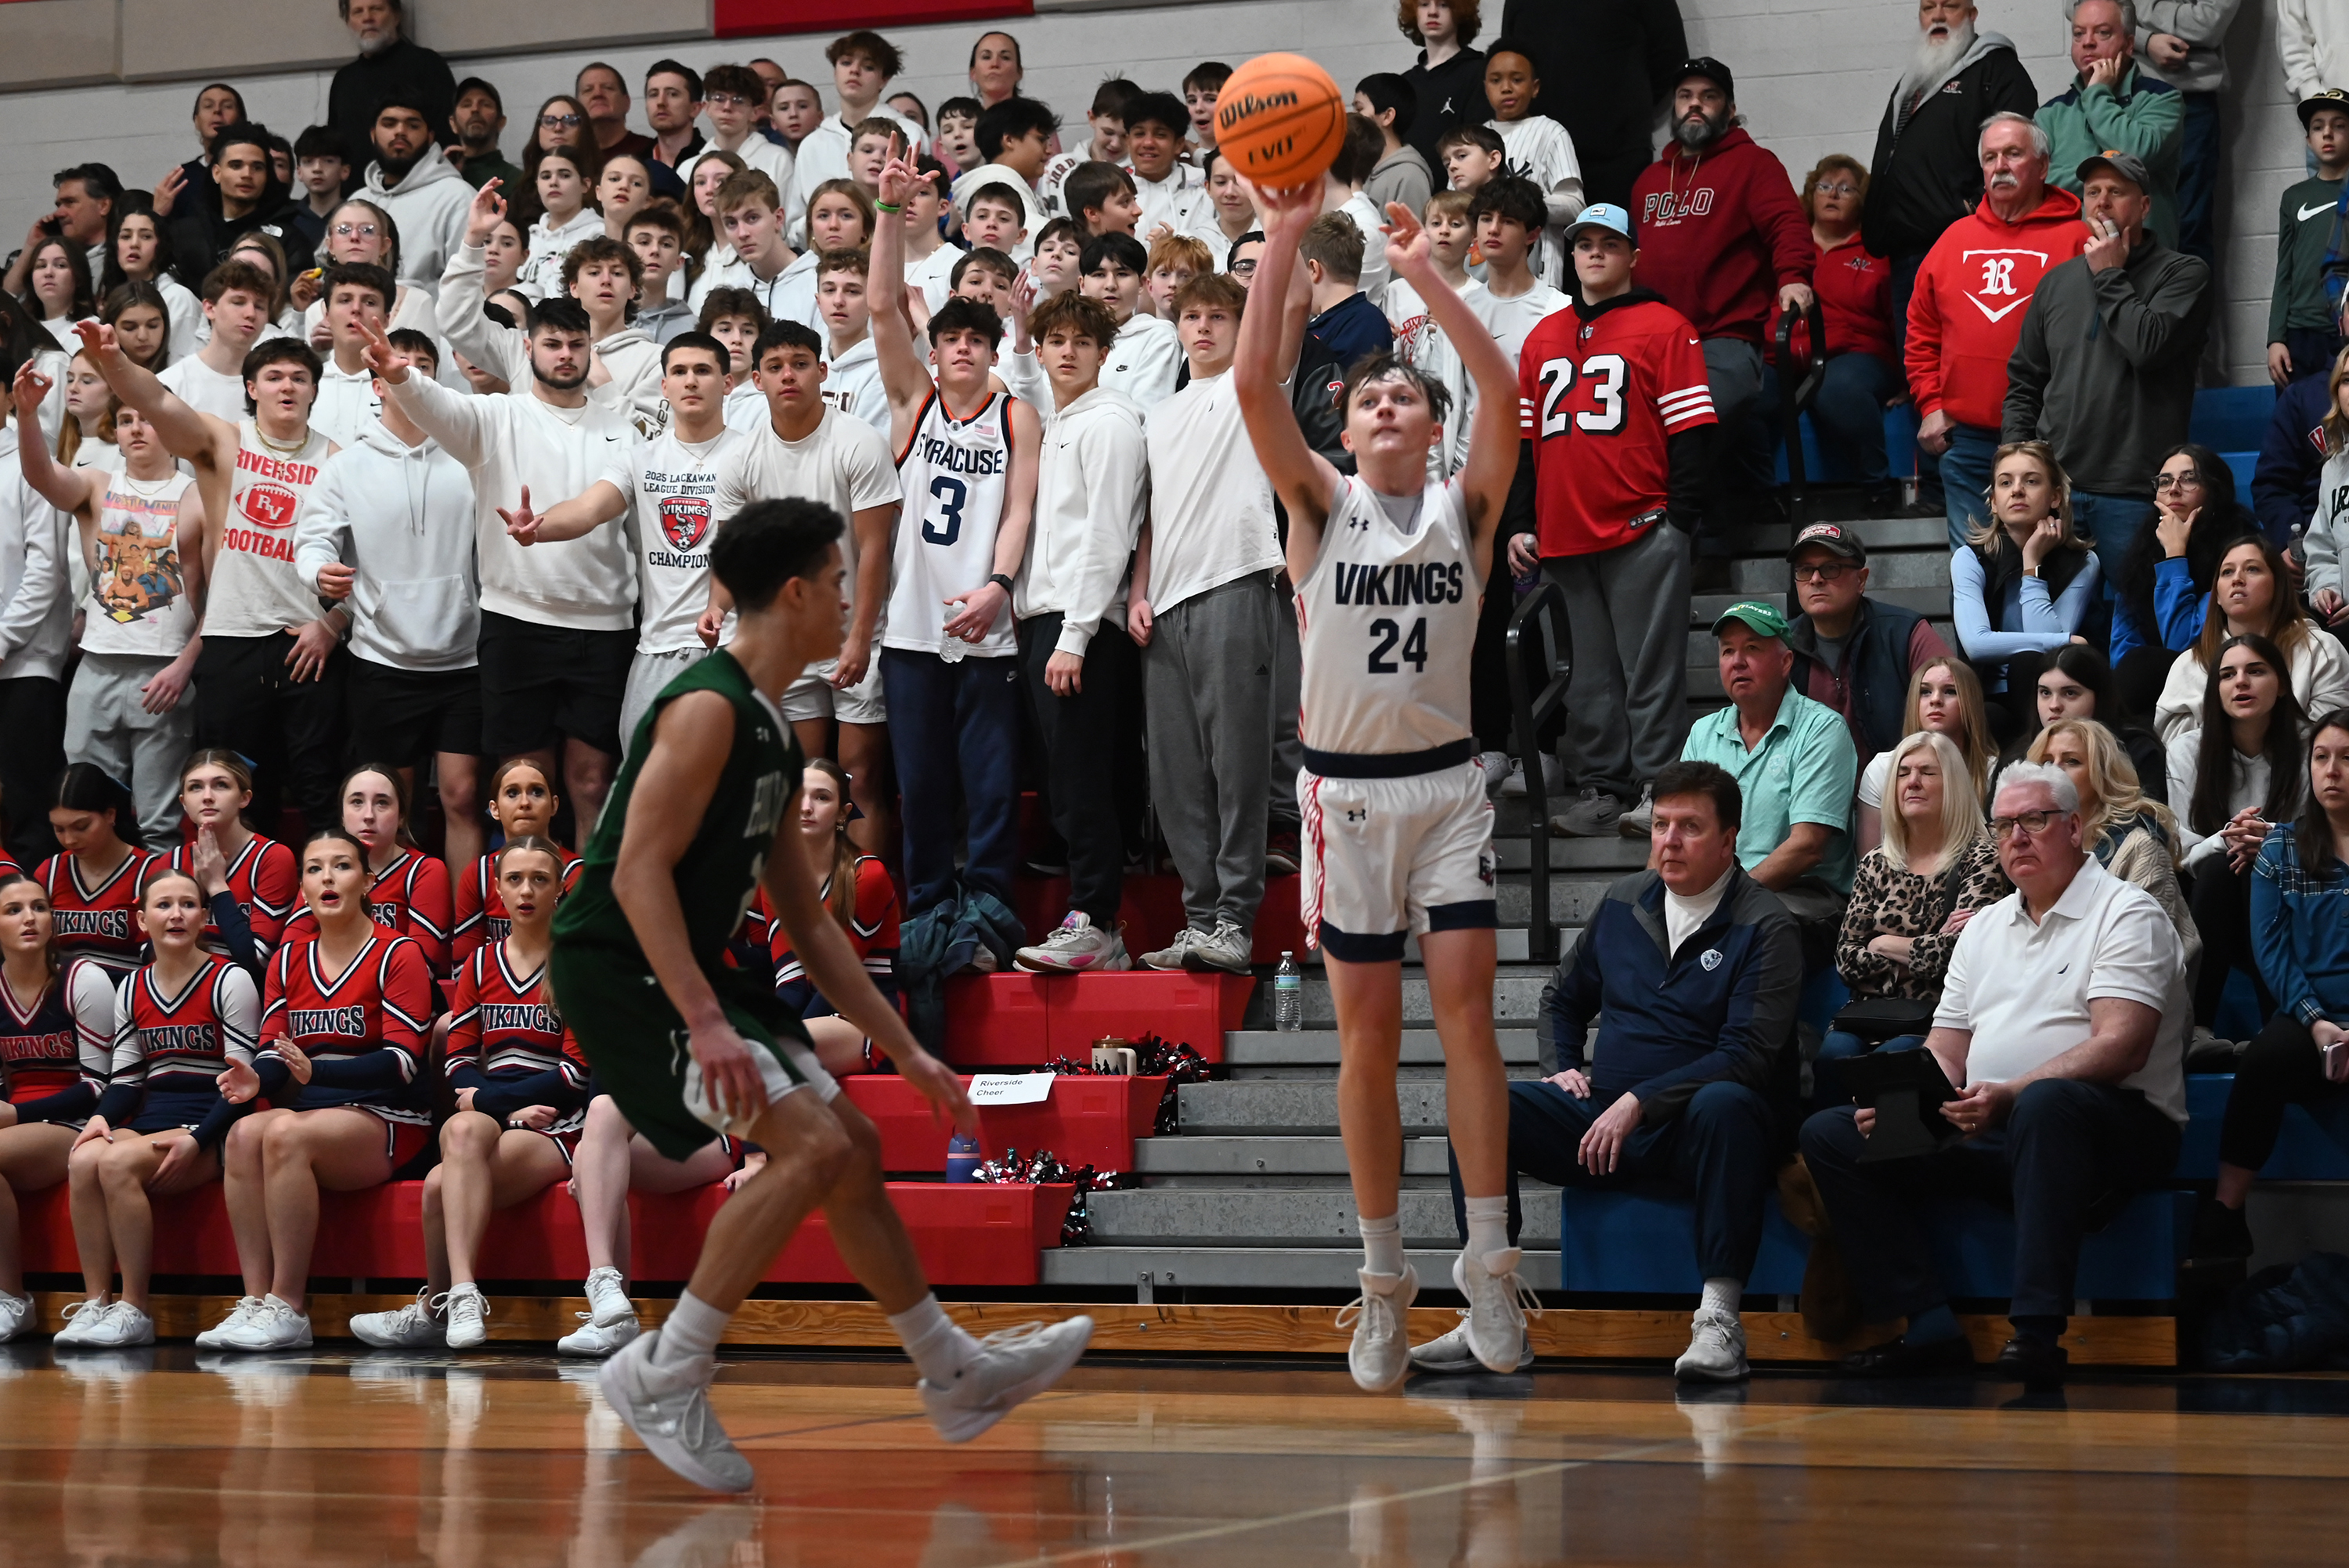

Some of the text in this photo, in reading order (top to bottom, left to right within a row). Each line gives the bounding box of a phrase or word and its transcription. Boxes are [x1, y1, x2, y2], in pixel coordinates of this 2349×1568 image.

[1219, 90, 1298, 130] Wilson
[1643, 188, 1715, 223] POLO
[1978, 258, 2018, 296] R
[1539, 354, 1631, 442] 23
[644, 470, 667, 483] 2025
[644, 482, 716, 496] LEAGUE DIVISION
[662, 504, 709, 517] VIKINGS
[921, 475, 968, 546] 3
[1335, 561, 1463, 607] VIKINGS
[1367, 617, 1428, 674] 24
[287, 1005, 366, 1041] VIKINGS
[479, 1003, 564, 1036] VIKINGS
